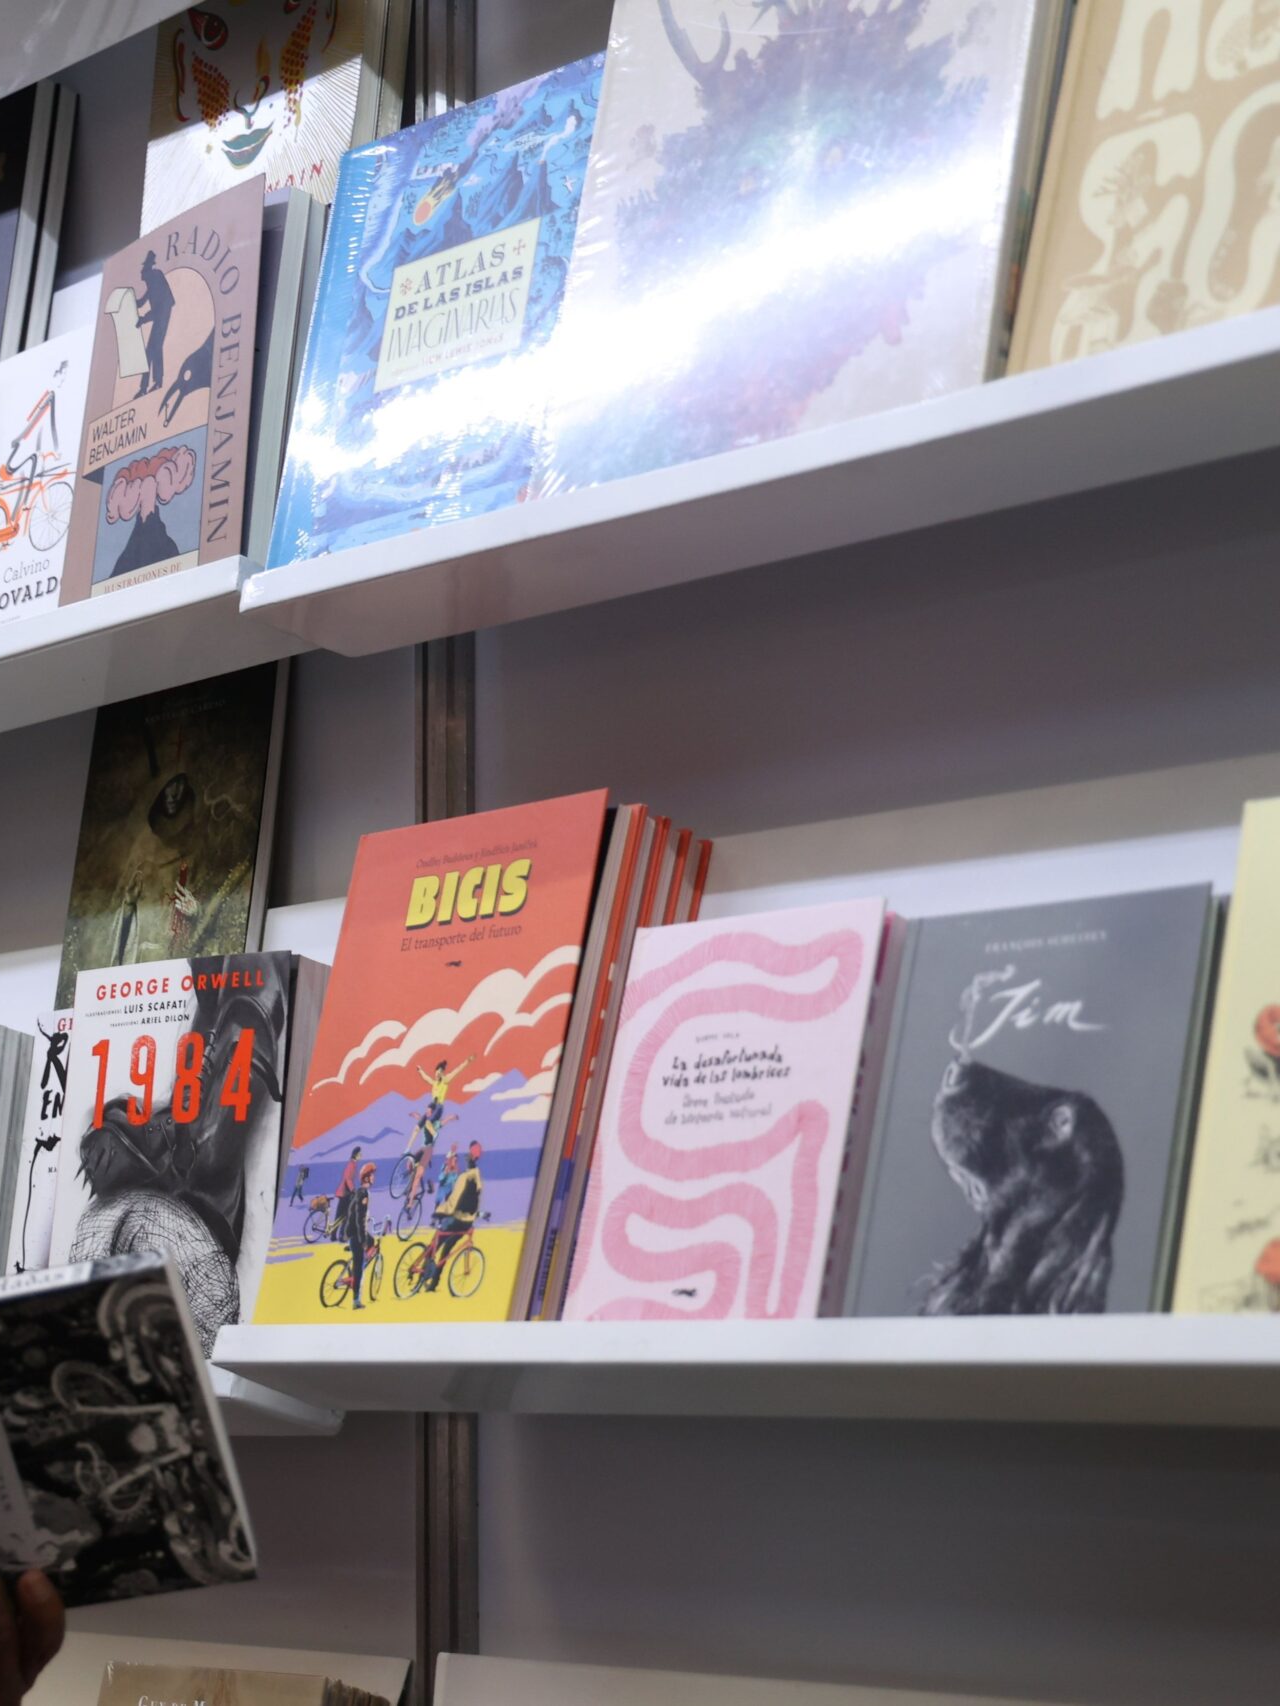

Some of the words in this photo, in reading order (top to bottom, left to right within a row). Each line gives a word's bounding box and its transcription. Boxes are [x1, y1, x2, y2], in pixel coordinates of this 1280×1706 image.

[414, 242, 506, 295] ATLAS
[394, 301, 418, 321] DE
[423, 287, 460, 312] LAS
[464, 266, 524, 298] ISLAS
[165, 225, 241, 297] RADIO
[207, 312, 242, 545] BENJAMIN
[93, 408, 136, 443] WALTER
[89, 423, 147, 466] BENJAMIN
[3, 559, 50, 584] Calvino
[170, 562, 182, 574] DE
[405, 858, 532, 932] BICIS
[400, 937, 412, 952] El
[414, 932, 467, 951] transporte
[469, 925, 486, 942] del
[488, 923, 523, 939] futuro
[96, 978, 169, 1001] GEORGE
[181, 970, 265, 992] ORWELL
[124, 1003, 143, 1014] LUIS
[148, 1000, 187, 1011] SCAFATI
[141, 1016, 161, 1024] ARIEL
[165, 1014, 190, 1022] DILON
[672, 1055, 688, 1072] La
[693, 1043, 783, 1071] desafortunada
[92, 1028, 255, 1129] 1984
[662, 1073, 690, 1088] vida
[693, 1070, 707, 1085] de
[709, 1069, 728, 1084] las
[731, 1065, 791, 1083] lombrices
